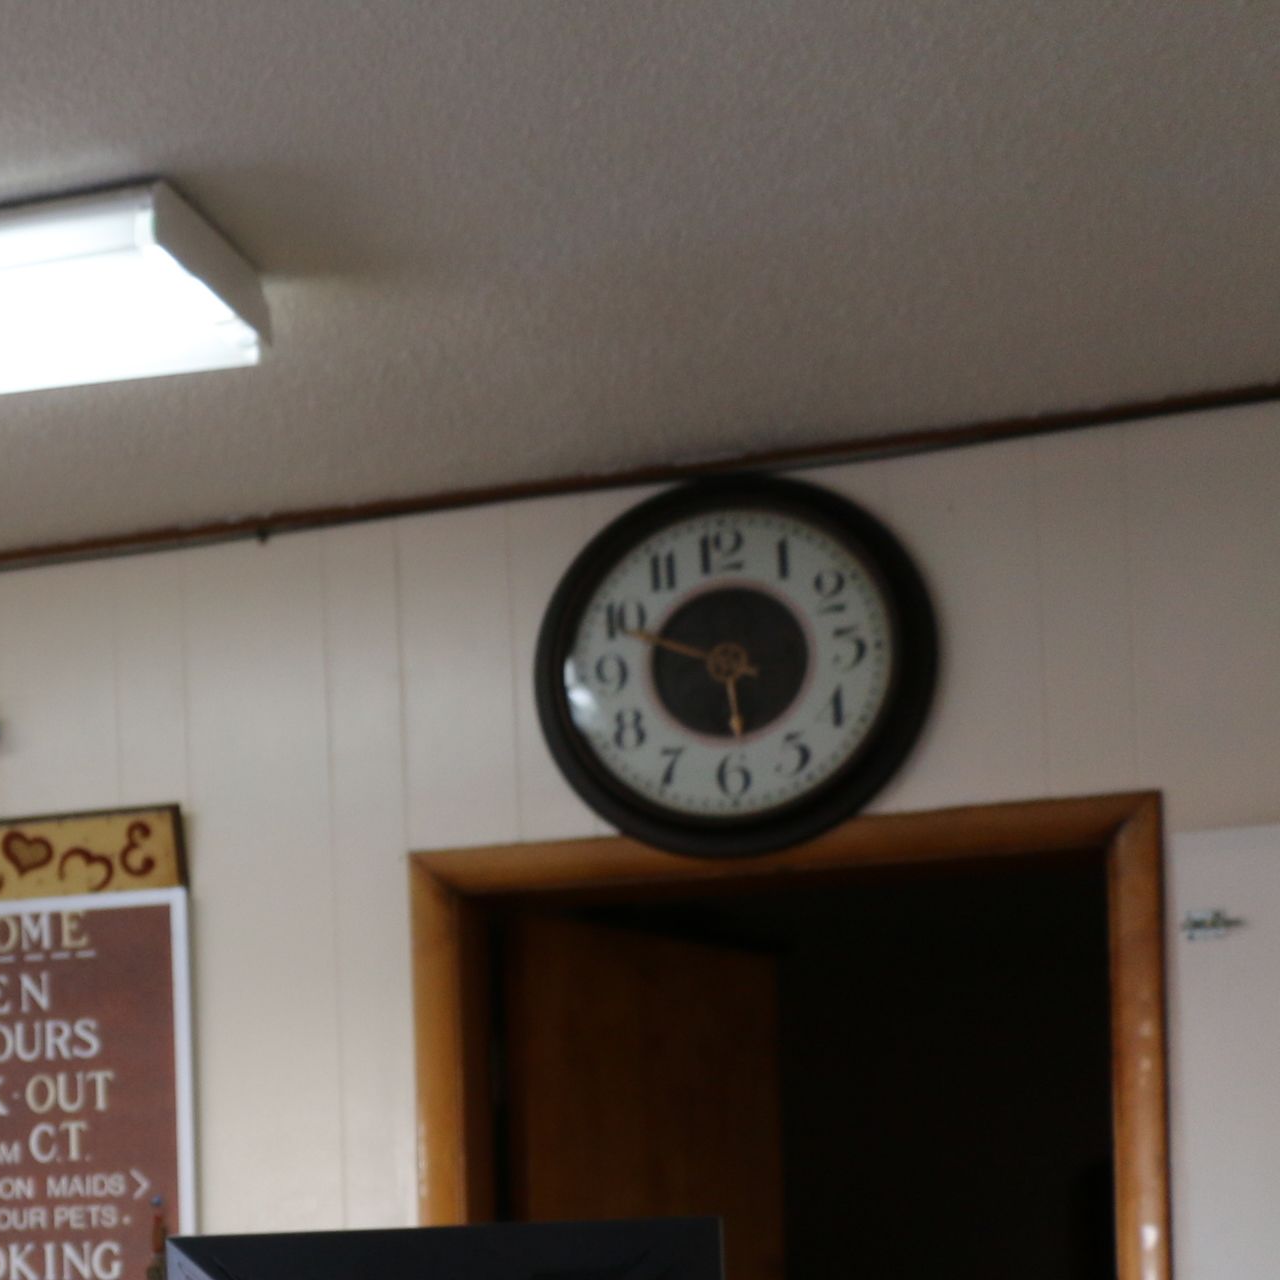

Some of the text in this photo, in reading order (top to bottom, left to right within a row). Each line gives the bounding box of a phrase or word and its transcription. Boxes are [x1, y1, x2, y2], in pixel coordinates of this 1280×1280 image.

[650, 552, 677, 592] 11
[699, 529, 745, 574] 12
[774, 536, 791, 580] 1
[814, 570, 846, 614] 2
[606, 599, 646, 640] 10
[833, 627, 866, 668] 3
[595, 654, 628, 694] 9
[817, 685, 845, 728] 4
[613, 709, 646, 749] 8
[659, 747, 683, 787] 7
[716, 753, 751, 795] 6
[776, 731, 811, 775] 5
[25, 1071, 114, 1114] OUT
